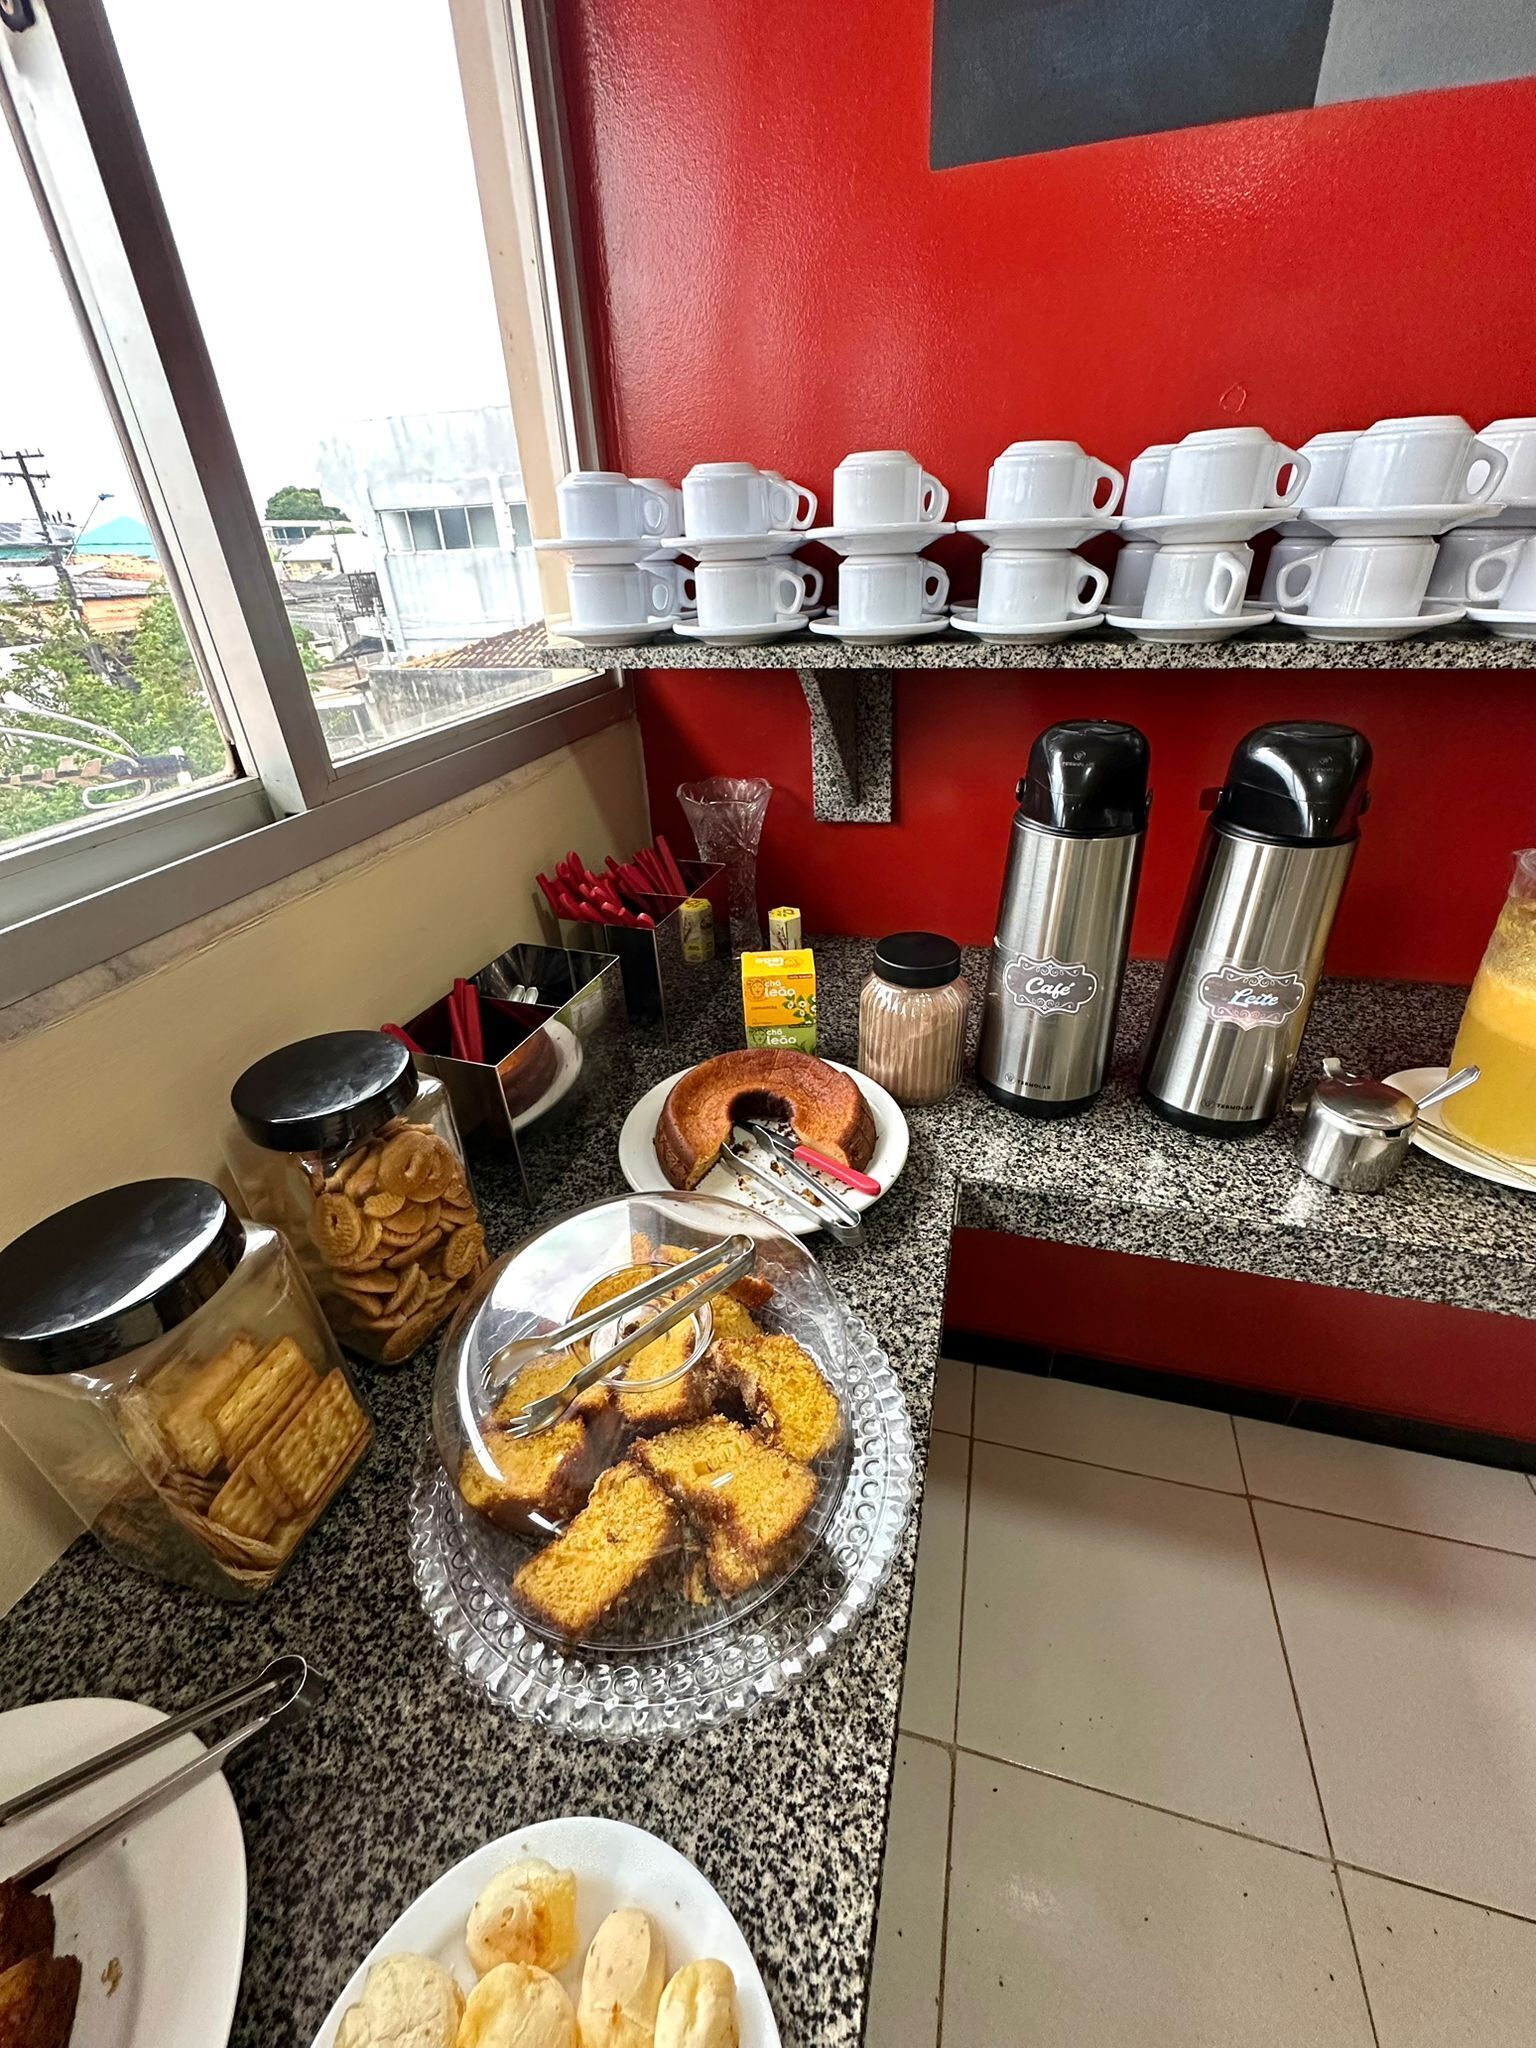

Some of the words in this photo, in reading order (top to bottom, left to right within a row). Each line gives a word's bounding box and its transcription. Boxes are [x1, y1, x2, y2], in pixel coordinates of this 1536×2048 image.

[764, 986, 796, 997] leão
[1025, 977, 1076, 1000] Café
[1227, 988, 1279, 1008] Leite
[766, 1028, 783, 1036] chá
[766, 1035, 797, 1045] leão
[1017, 1079, 1051, 1089] TERMOLAR
